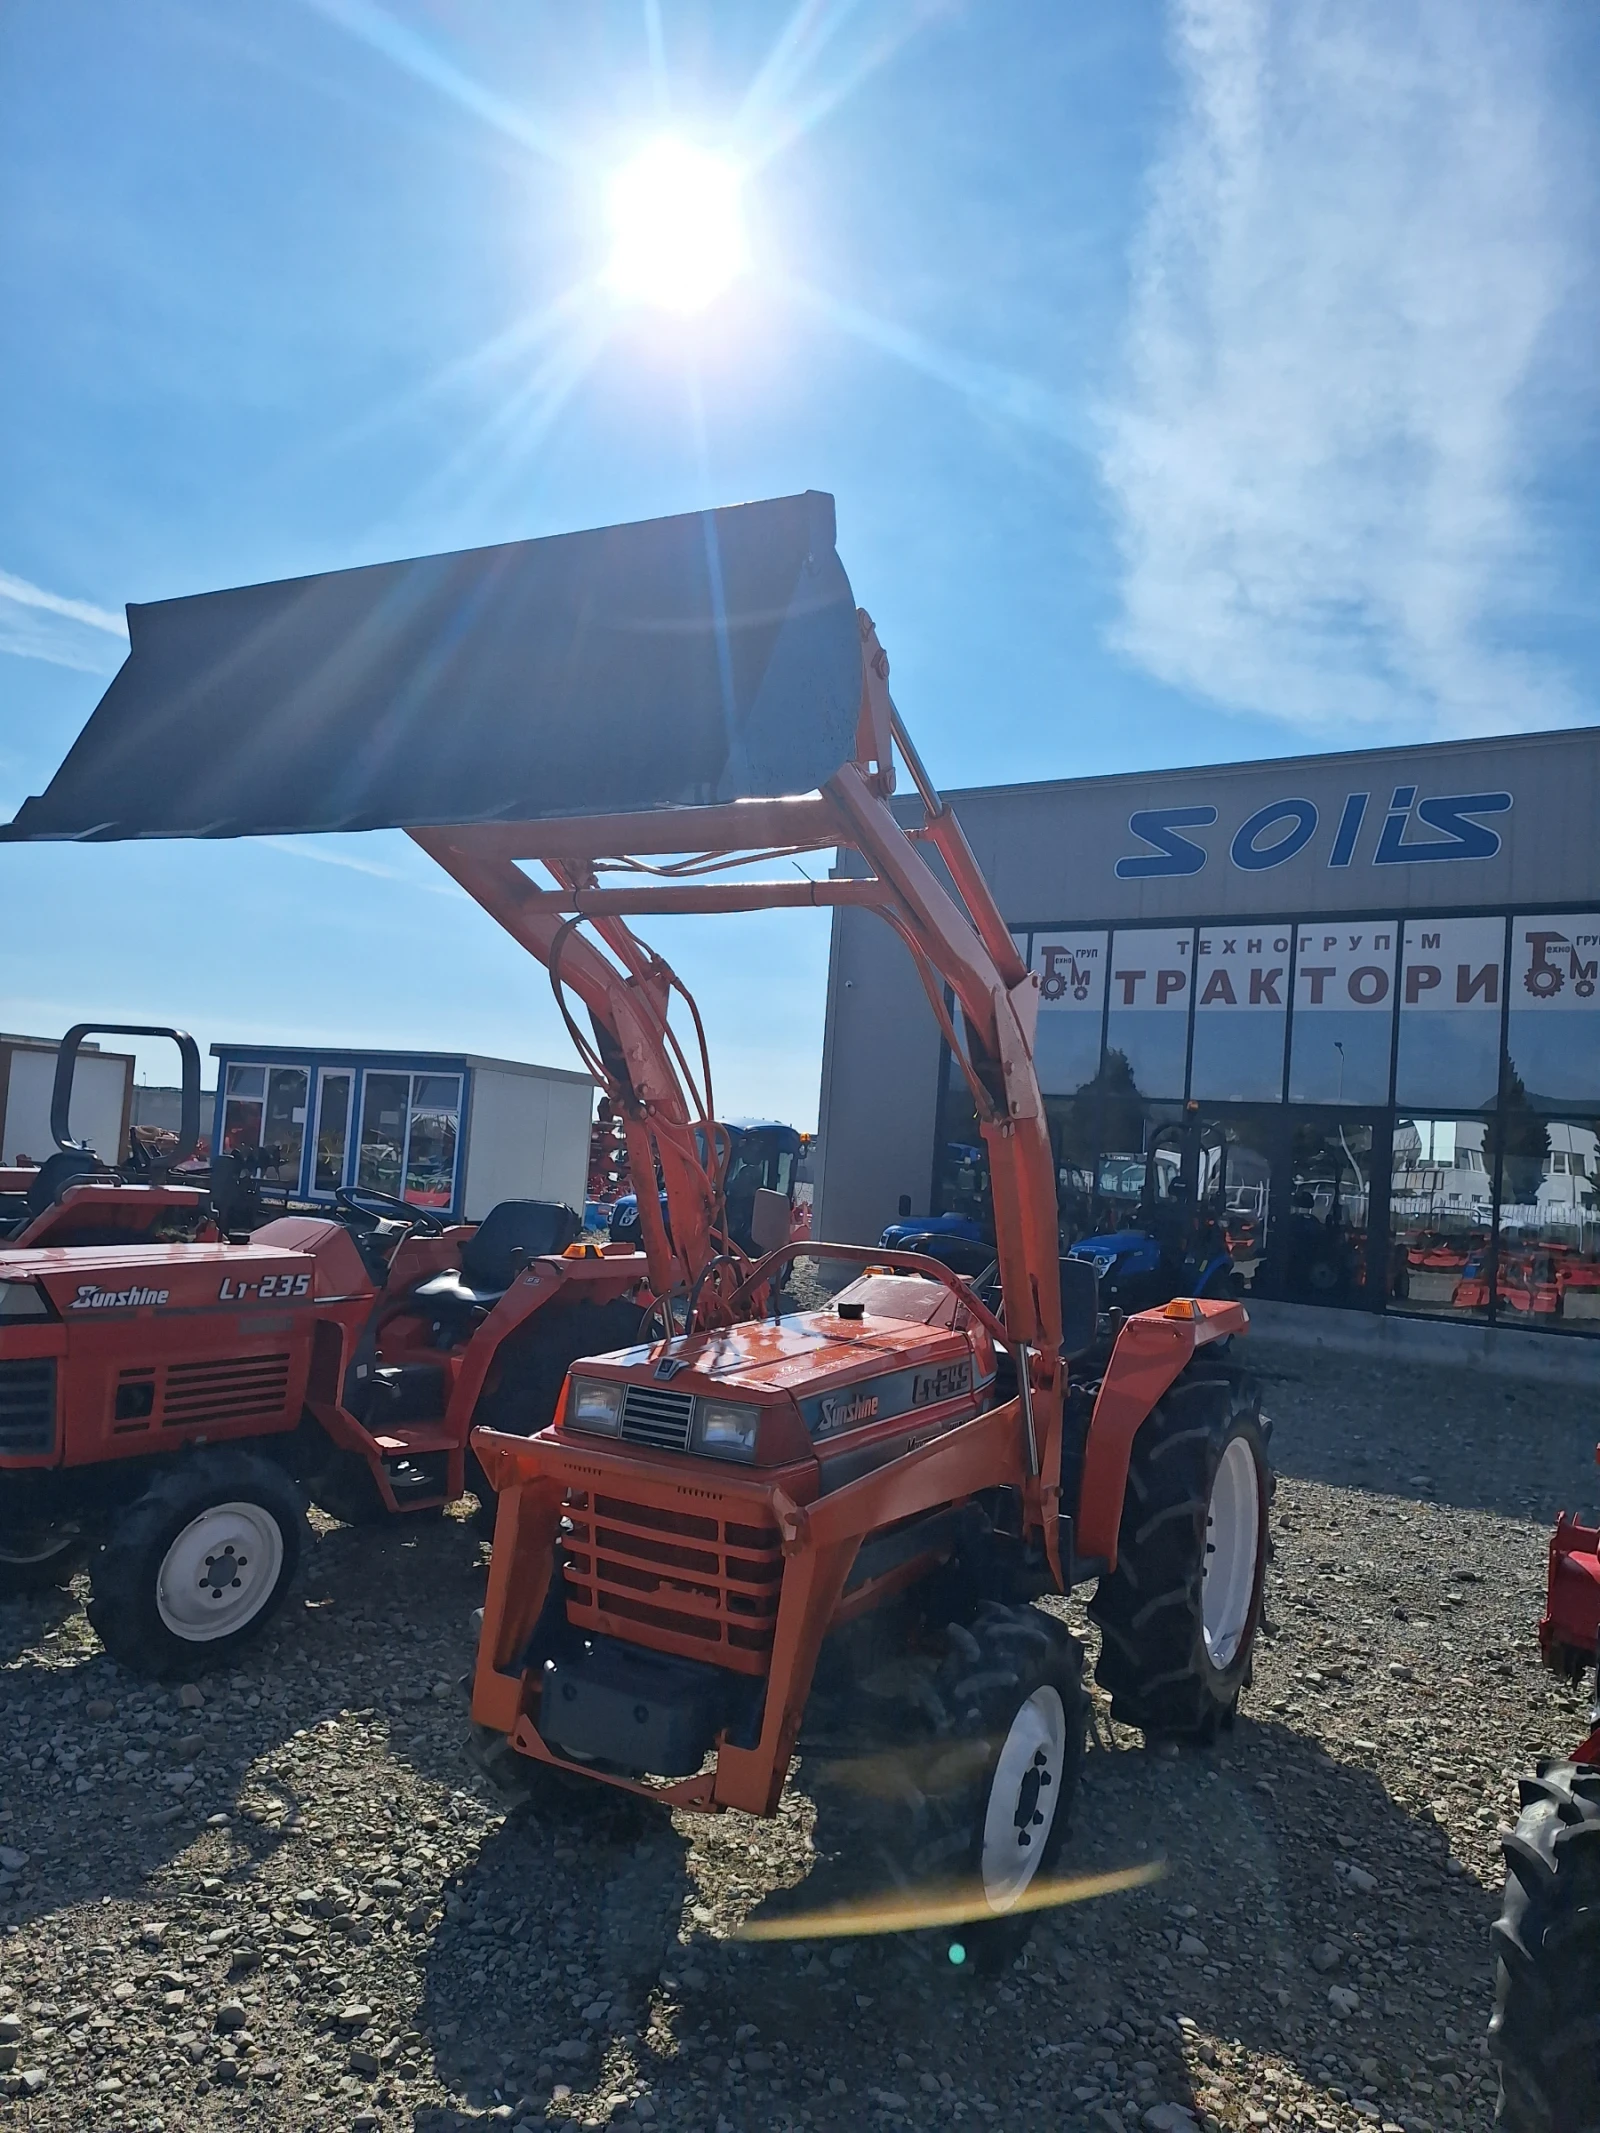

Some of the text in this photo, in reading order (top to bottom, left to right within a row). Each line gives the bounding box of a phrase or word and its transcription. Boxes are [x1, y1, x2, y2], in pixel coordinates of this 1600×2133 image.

[1076, 949, 1099, 958] ГРУП
[1114, 964, 1499, 1005] ТРАКТОРИ
[68, 1285, 170, 1309] Sunshine
[818, 1393, 879, 1431] Sunshine
